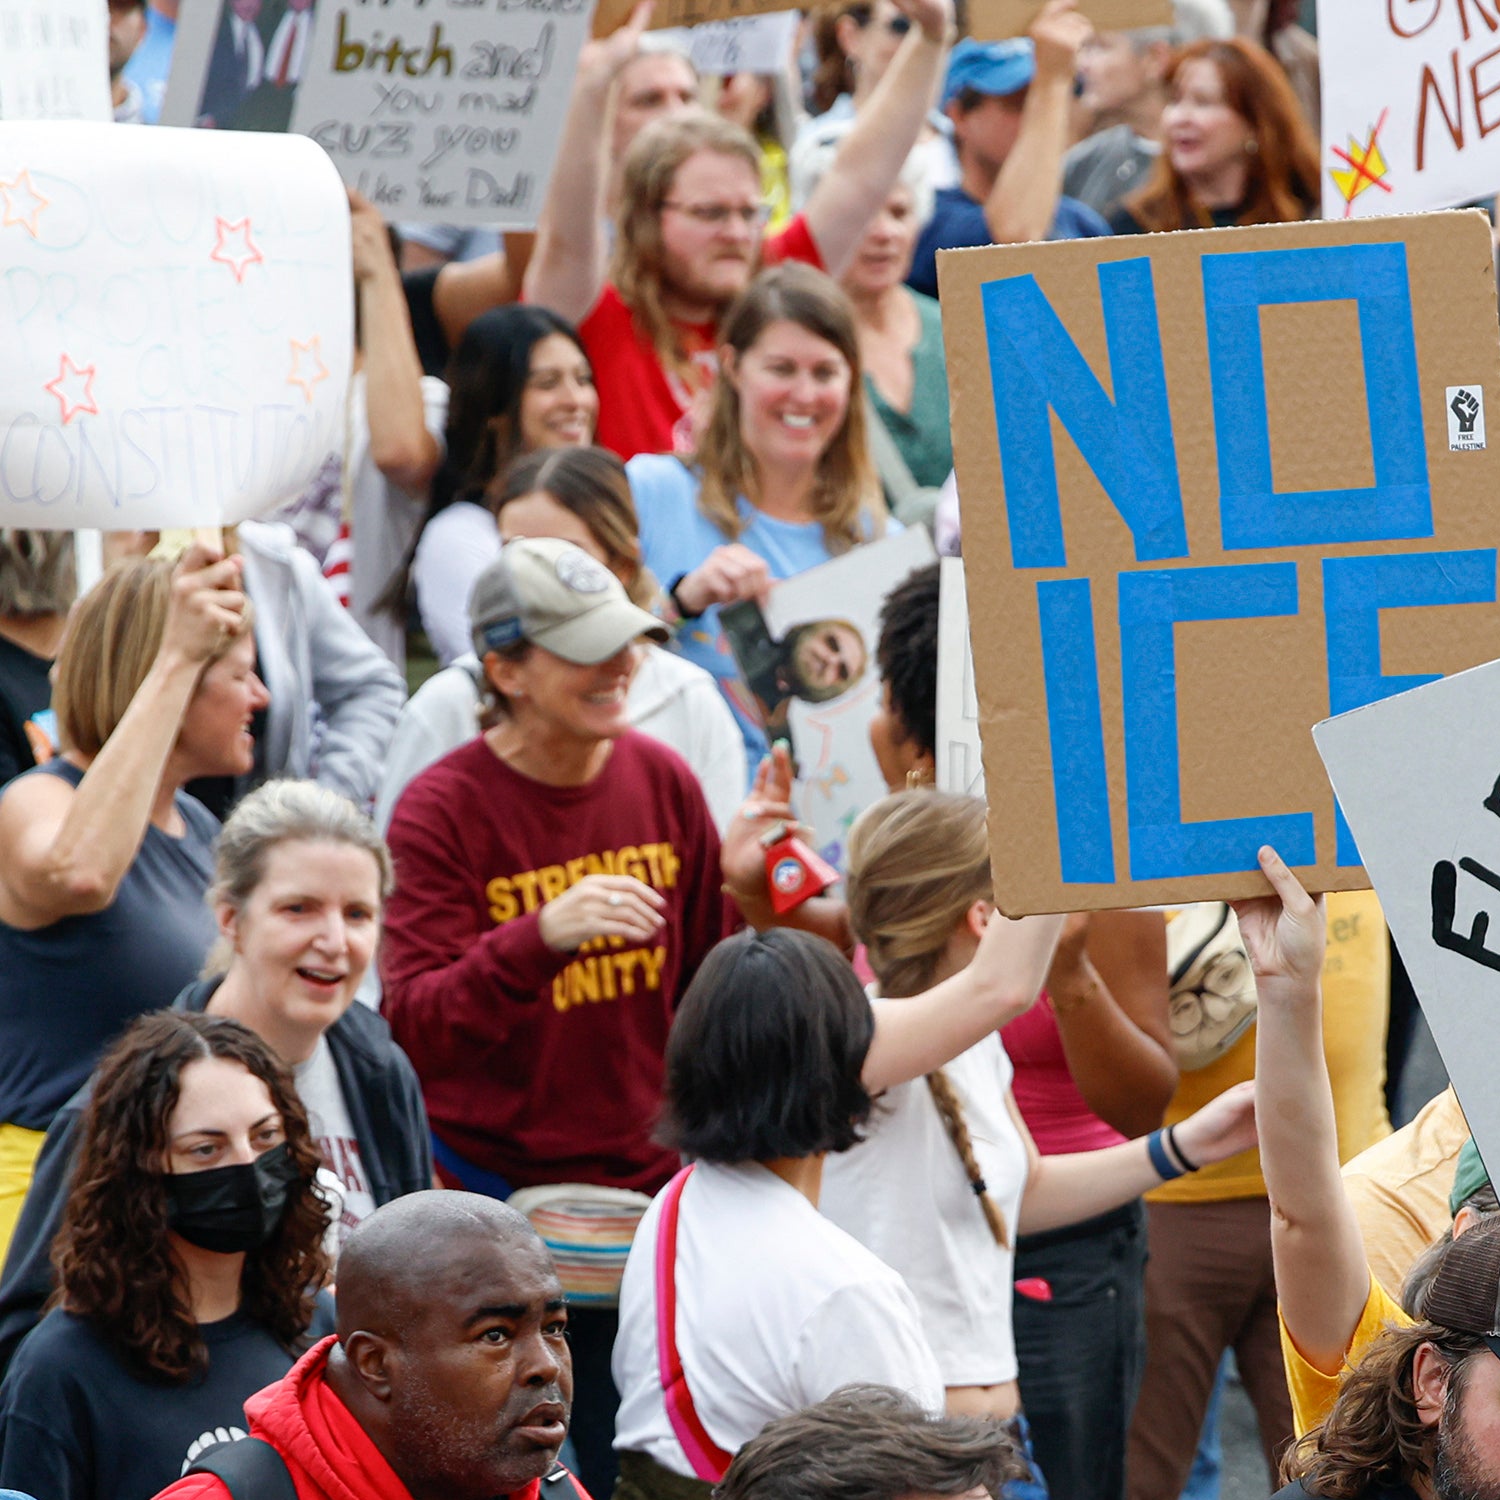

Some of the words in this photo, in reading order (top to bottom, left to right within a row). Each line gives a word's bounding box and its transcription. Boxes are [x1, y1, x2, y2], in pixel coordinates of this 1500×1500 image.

[333, 9, 454, 76] bitch
[460, 20, 554, 80] and
[138, 343, 247, 400] OUR
[980, 242, 1434, 568] NO
[1451, 442, 1484, 451] PALESTINE
[1036, 548, 1497, 884] ICE
[552, 946, 667, 1012] UNITY
